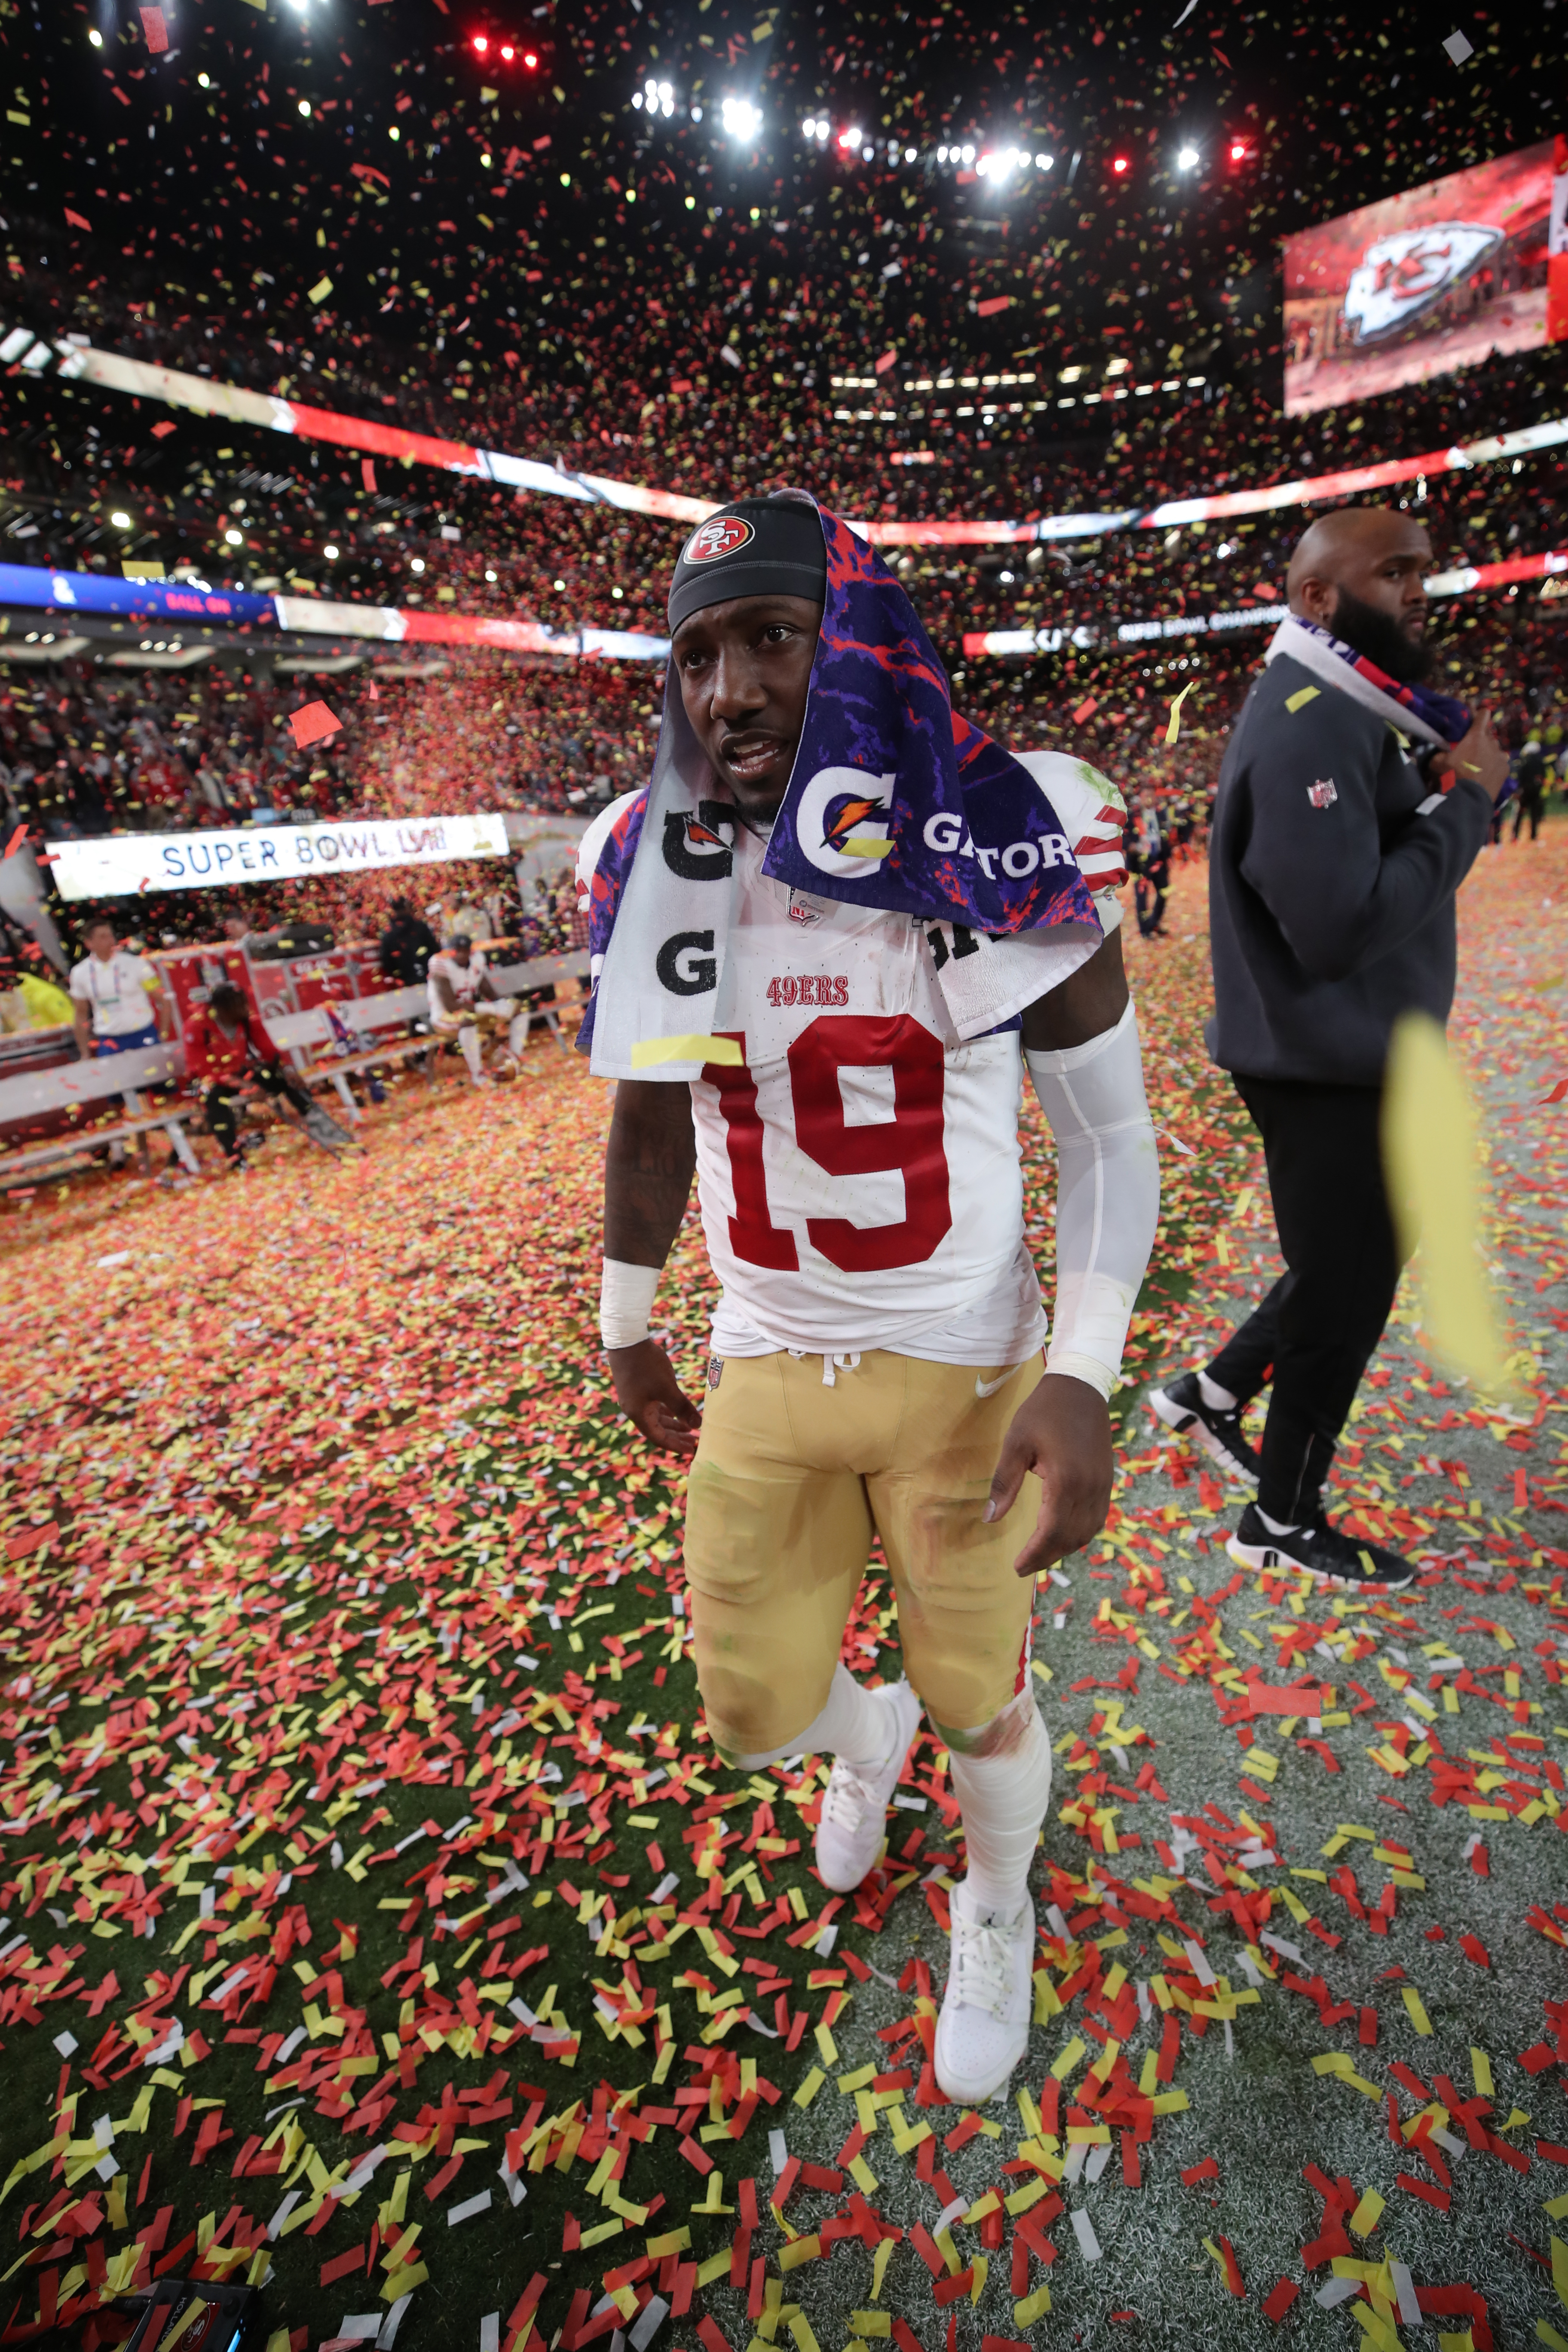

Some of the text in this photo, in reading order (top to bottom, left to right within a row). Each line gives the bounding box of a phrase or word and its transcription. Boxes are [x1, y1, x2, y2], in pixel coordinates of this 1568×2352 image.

[163, 840, 279, 878] SUPER
[297, 829, 389, 864] BOWL
[796, 766, 896, 879] G
[656, 929, 717, 996] G
[766, 975, 849, 1007] 49ERS
[701, 1013, 953, 1273] 19
